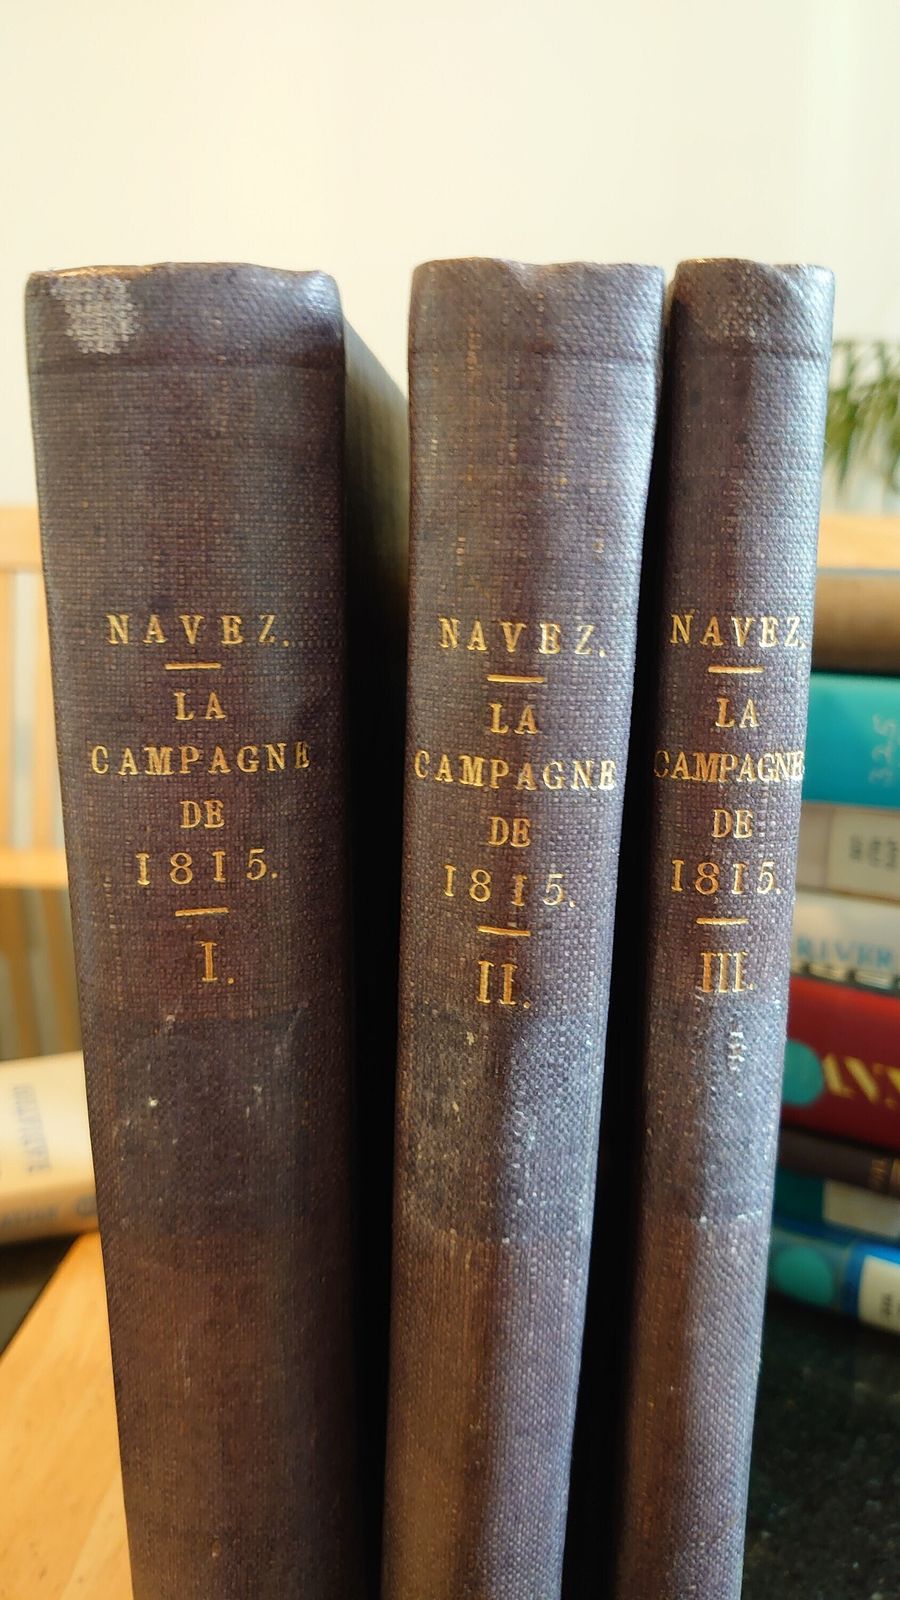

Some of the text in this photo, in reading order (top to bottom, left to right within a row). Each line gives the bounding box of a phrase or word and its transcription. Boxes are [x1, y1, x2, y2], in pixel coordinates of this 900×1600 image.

[106, 614, 290, 645] NAVEZ.
[438, 616, 606, 658] NAVEZ.
[669, 614, 807, 648] NAVEZ.
[173, 691, 226, 721] LA
[489, 702, 539, 735] LA
[715, 697, 760, 729] LA
[91, 741, 310, 776] CAMPAGNE
[414, 750, 617, 791] CAMPAGNE
[652, 750, 806, 784] CAMPAGNE
[179, 800, 225, 829] DE
[712, 808, 753, 839] DE
[488, 816, 532, 848] DE
[135, 848, 279, 886] 1815.
[670, 859, 782, 896] 1815.
[444, 864, 577, 908] 1815.
[199, 940, 235, 985] I.
[699, 951, 754, 993] III.
[477, 959, 532, 1010] II.
